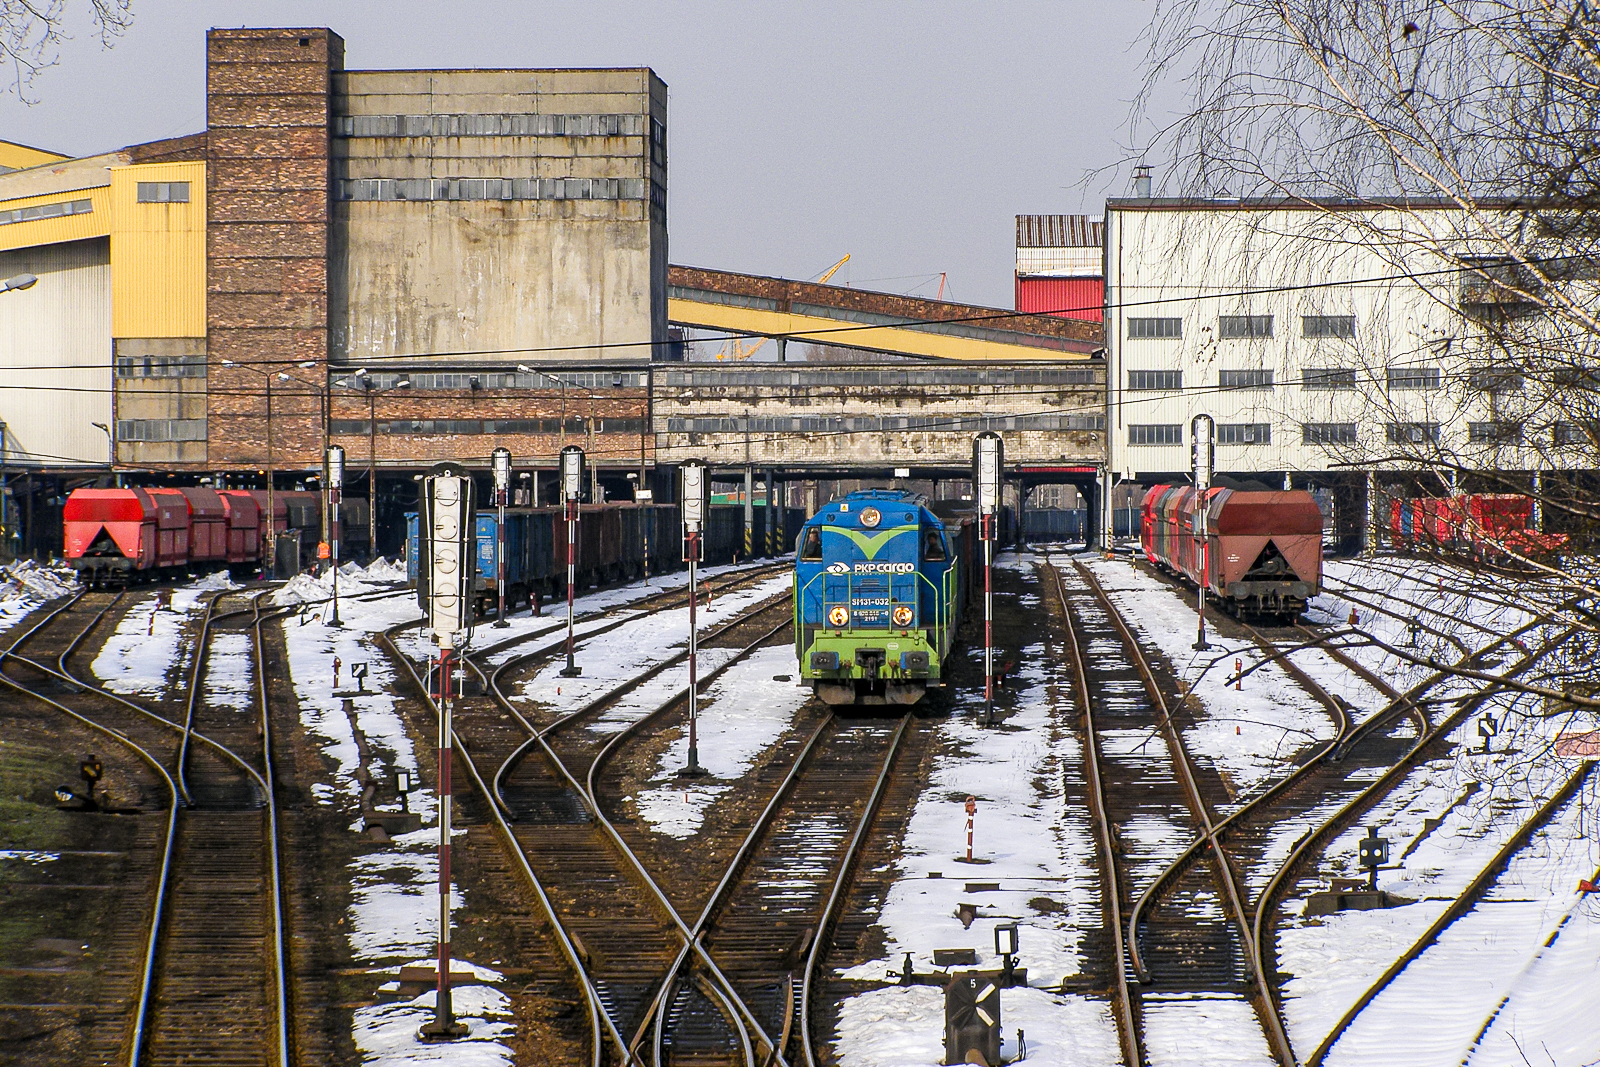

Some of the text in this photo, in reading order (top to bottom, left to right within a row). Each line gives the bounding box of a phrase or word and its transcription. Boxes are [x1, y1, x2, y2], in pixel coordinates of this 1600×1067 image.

[854, 562, 914, 575] PKP cargo
[970, 978, 977, 988] 5
